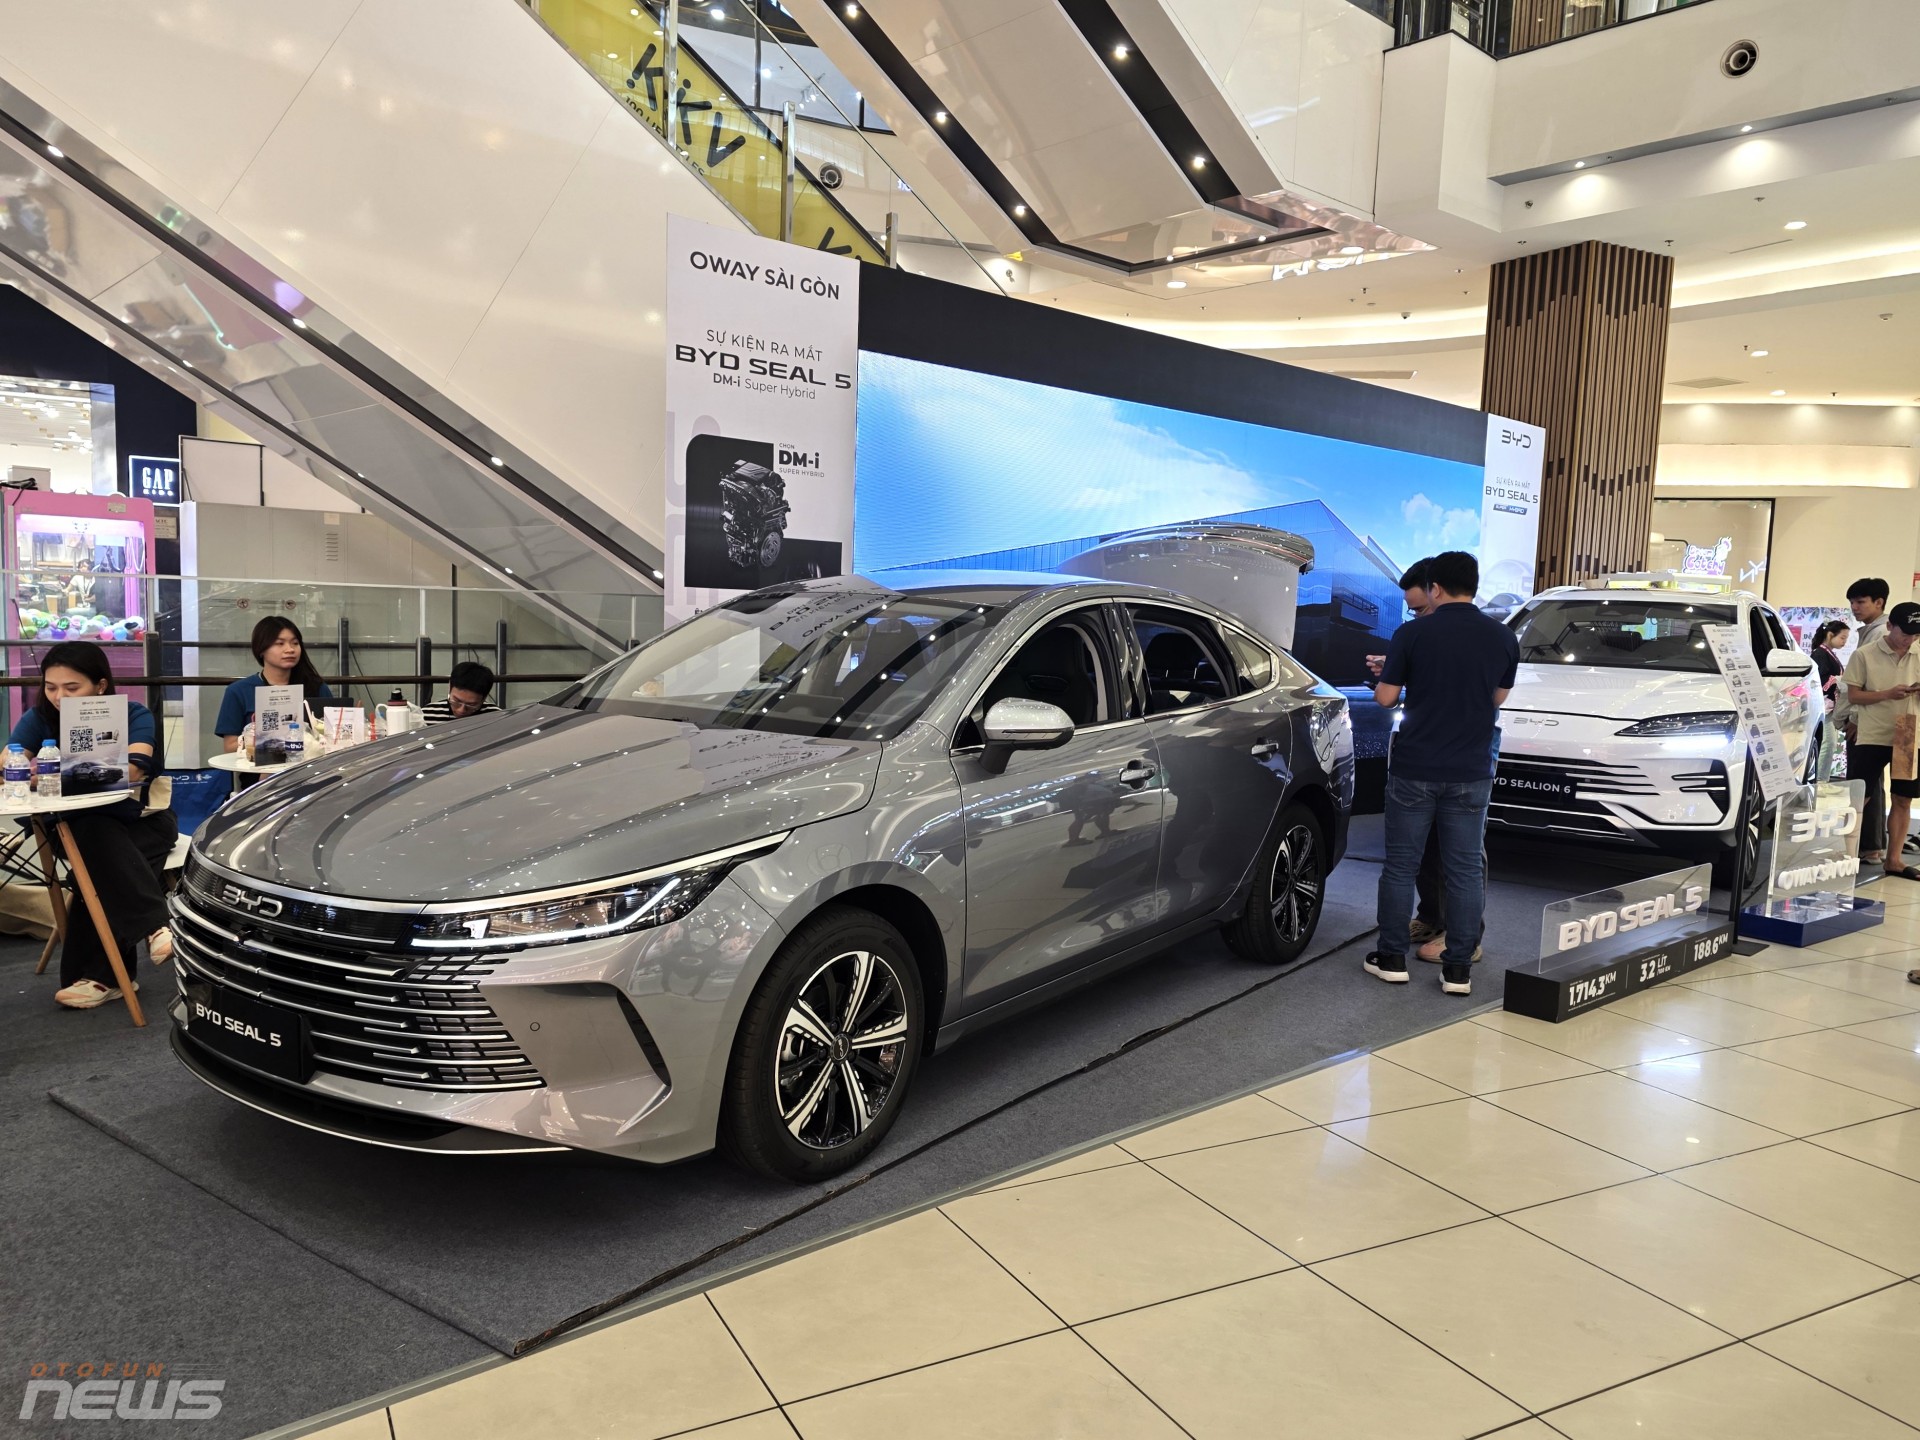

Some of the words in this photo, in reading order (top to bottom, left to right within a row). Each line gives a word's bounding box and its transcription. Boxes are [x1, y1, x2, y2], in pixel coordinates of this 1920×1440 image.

[690, 251, 760, 281] OWAY
[764, 267, 794, 290] SÀI
[800, 276, 840, 300] GÒN
[706, 329, 726, 347] SỰ
[731, 335, 765, 352] KIỆN
[771, 342, 789, 356] RA
[794, 345, 823, 362] MẮT
[675, 344, 740, 371] BYD
[749, 358, 827, 386] SEAL
[835, 373, 852, 390] 5
[713, 372, 741, 387] DM-i
[744, 378, 777, 396] Super
[780, 385, 816, 400] Hybrid
[1501, 429, 1531, 449] BYD
[779, 450, 819, 469] DM-i
[142, 466, 174, 490] GAP
[802, 470, 825, 478] HYBRID
[1485, 486, 1505, 498] BYD
[1507, 490, 1530, 503] SEAL
[1513, 717, 1559, 727] BYD
[1510, 779, 1560, 792] SEALION
[1563, 785, 1571, 794] 6
[1791, 807, 1857, 842] BYD
[222, 884, 283, 918] BYD
[1558, 910, 1617, 951] BYD
[1619, 893, 1683, 932] SEAL
[1685, 886, 1702, 912] 5
[1640, 960, 1655, 982] 3.2
[1657, 954, 1668, 968] LÍT
[196, 1003, 221, 1026] BYD
[224, 1016, 266, 1043] SEAL
[270, 1033, 282, 1047] 5
